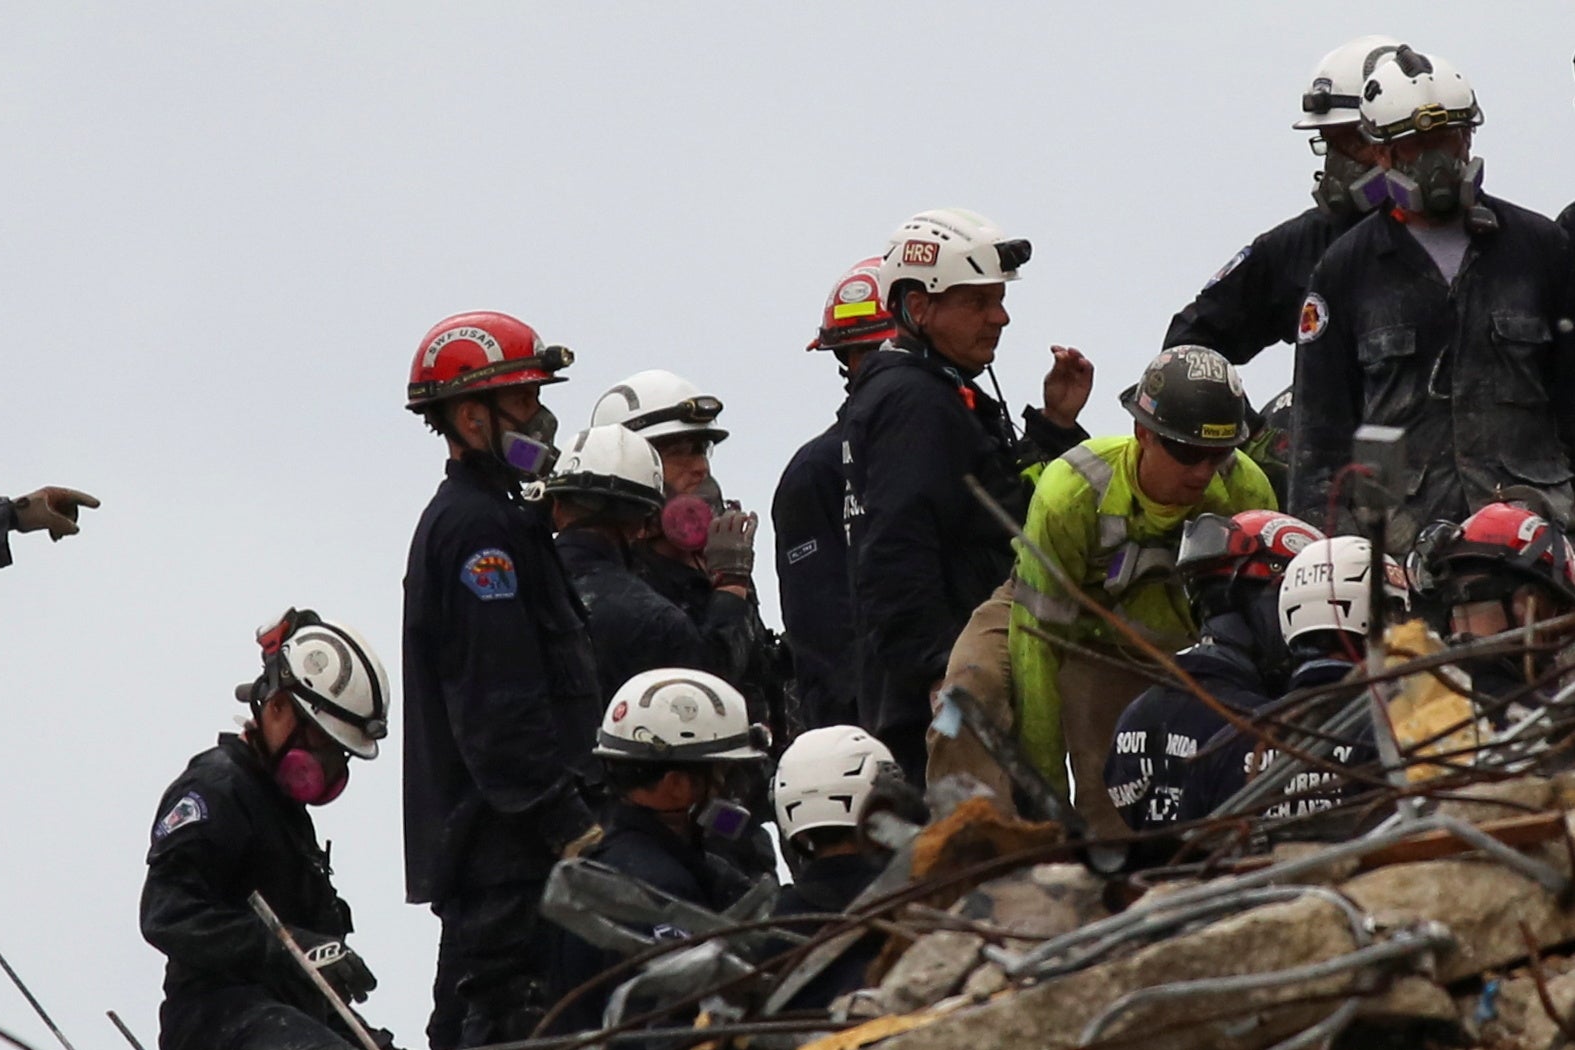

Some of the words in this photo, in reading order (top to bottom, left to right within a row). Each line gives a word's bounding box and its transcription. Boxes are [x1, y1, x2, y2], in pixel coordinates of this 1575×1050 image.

[904, 243, 934, 263] HRS
[429, 333, 454, 354] SWF
[459, 329, 495, 349] USAR
[1186, 351, 1226, 382] 215
[1117, 731, 1147, 754] SOUT
